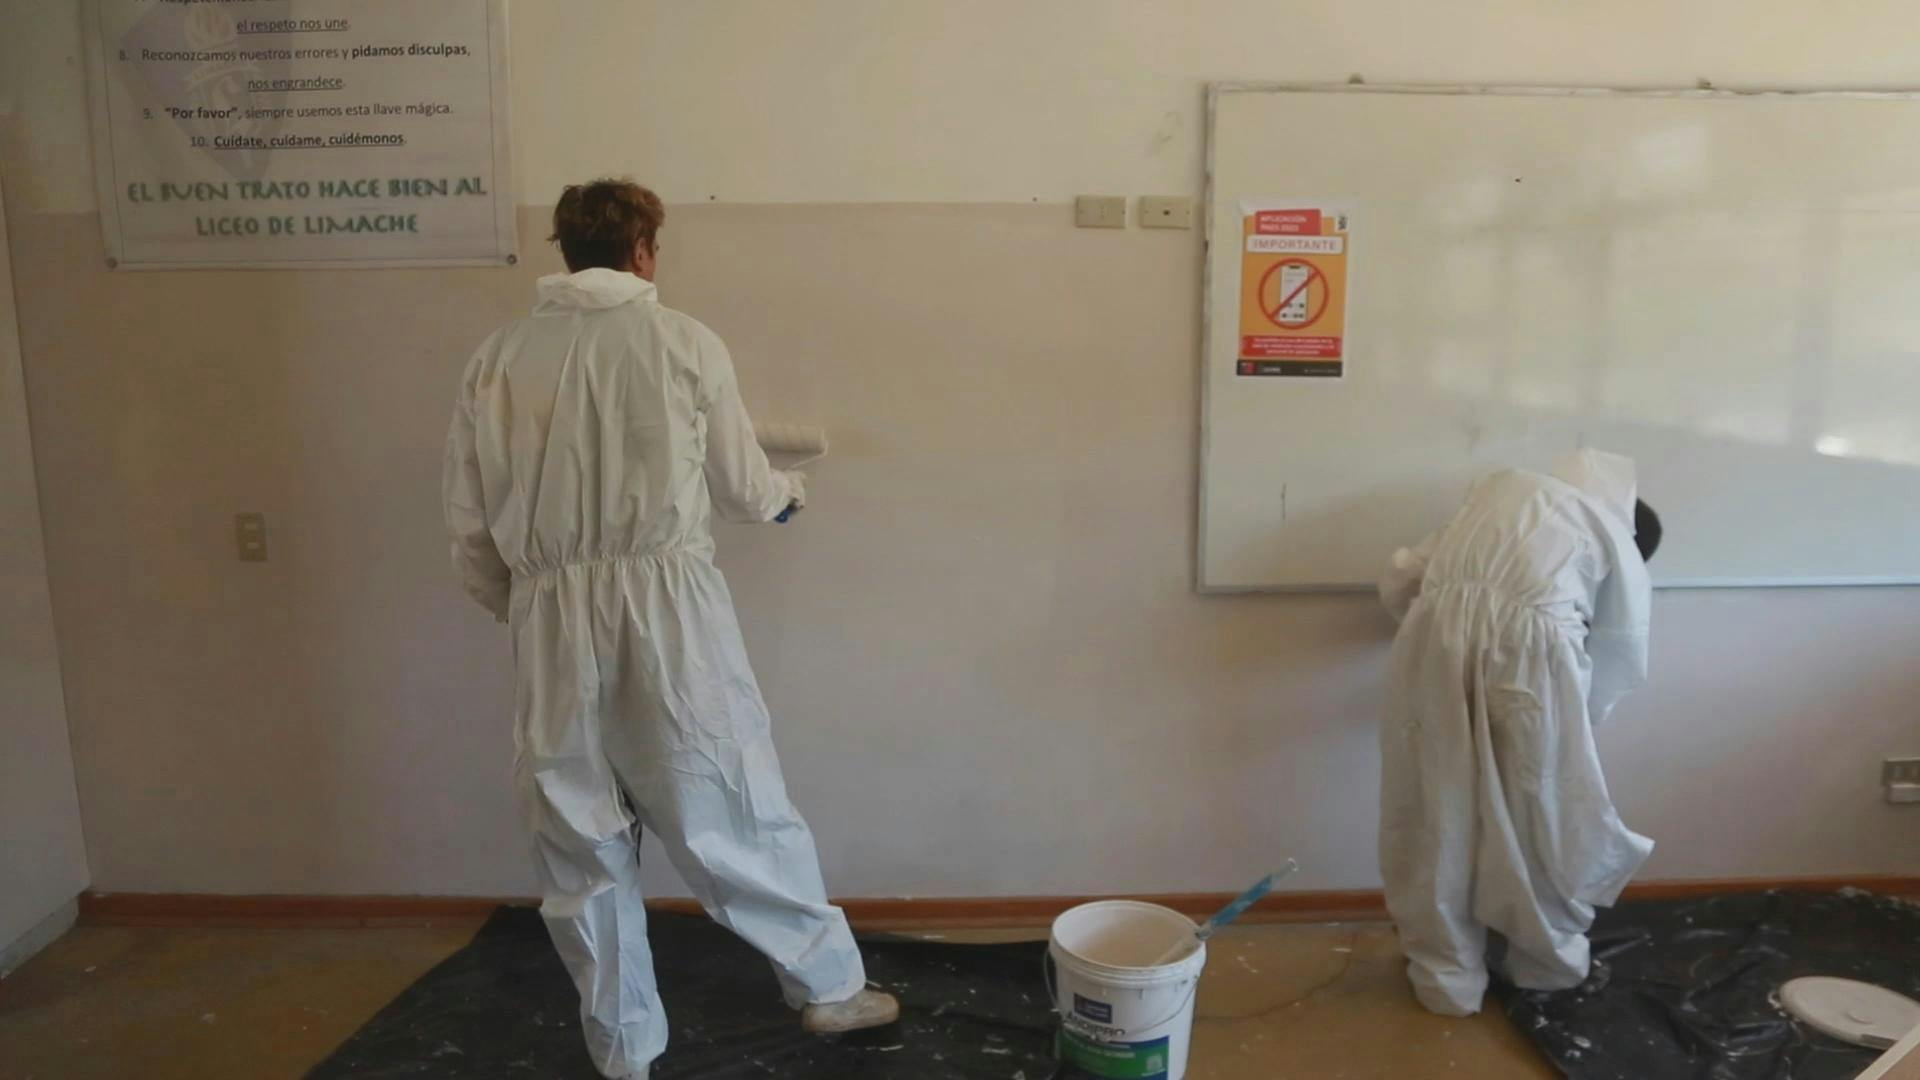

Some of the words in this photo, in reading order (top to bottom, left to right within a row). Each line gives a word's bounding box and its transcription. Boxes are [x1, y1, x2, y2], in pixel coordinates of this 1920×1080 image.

[236, 19, 248, 31] el
[251, 19, 297, 34] respeto
[300, 20, 322, 30] nos
[325, 18, 350, 29] une.
[142, 49, 236, 61] Reconozcamos
[239, 50, 291, 61] nuestros
[295, 50, 338, 60] errores
[342, 50, 350, 60] y
[352, 45, 404, 59] pidamos
[407, 43, 471, 58] disculpas,
[248, 79, 270, 90] nos
[272, 76, 346, 91] engrandece.
[245, 107, 293, 121] siempre
[297, 106, 342, 117] usemos
[345, 105, 370, 116] esta
[373, 103, 402, 115] llave
[405, 103, 453, 118] mágica.
[127, 182, 154, 202] EL
[160, 182, 228, 201] BUEN
[236, 180, 310, 200] TRATO
[318, 178, 381, 198] HACE
[388, 178, 448, 198] BIEN
[454, 176, 487, 196] AL
[195, 216, 260, 236] LICEO
[268, 216, 296, 235] DE
[303, 214, 419, 235] LIMACHE
[1254, 239, 1335, 250] IMPORTANTE
